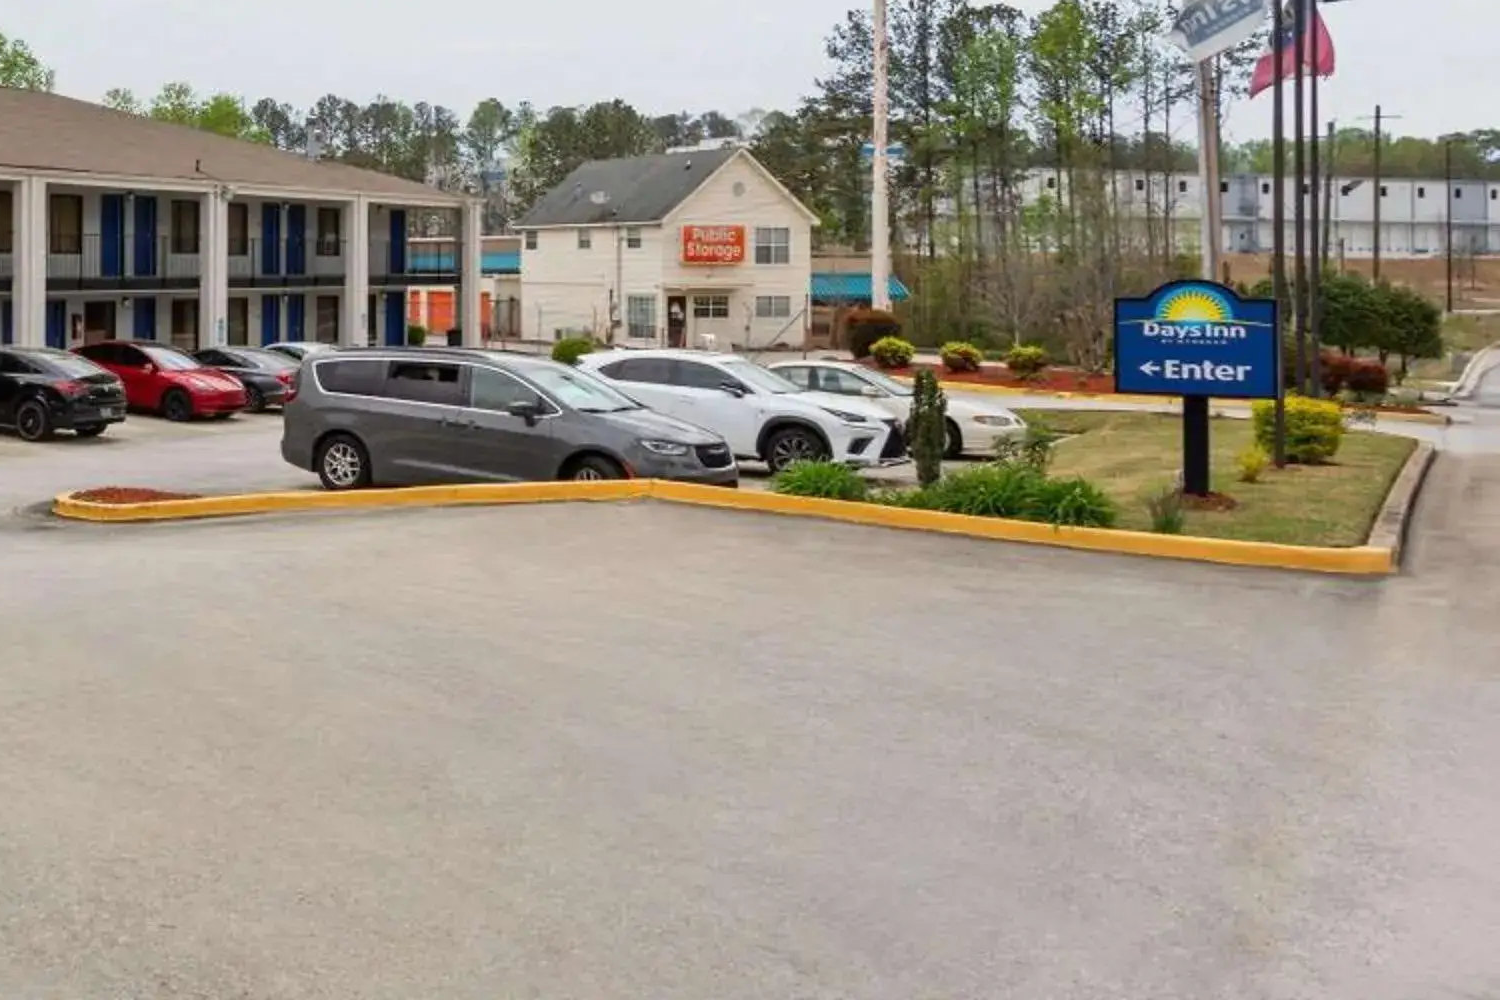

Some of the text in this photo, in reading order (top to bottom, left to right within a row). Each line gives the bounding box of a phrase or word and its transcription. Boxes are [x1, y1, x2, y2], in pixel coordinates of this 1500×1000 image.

[692, 228, 737, 242] Public
[687, 241, 741, 260] Storage
[1143, 321, 1246, 339] Days Inn
[1164, 359, 1252, 381] Enter
